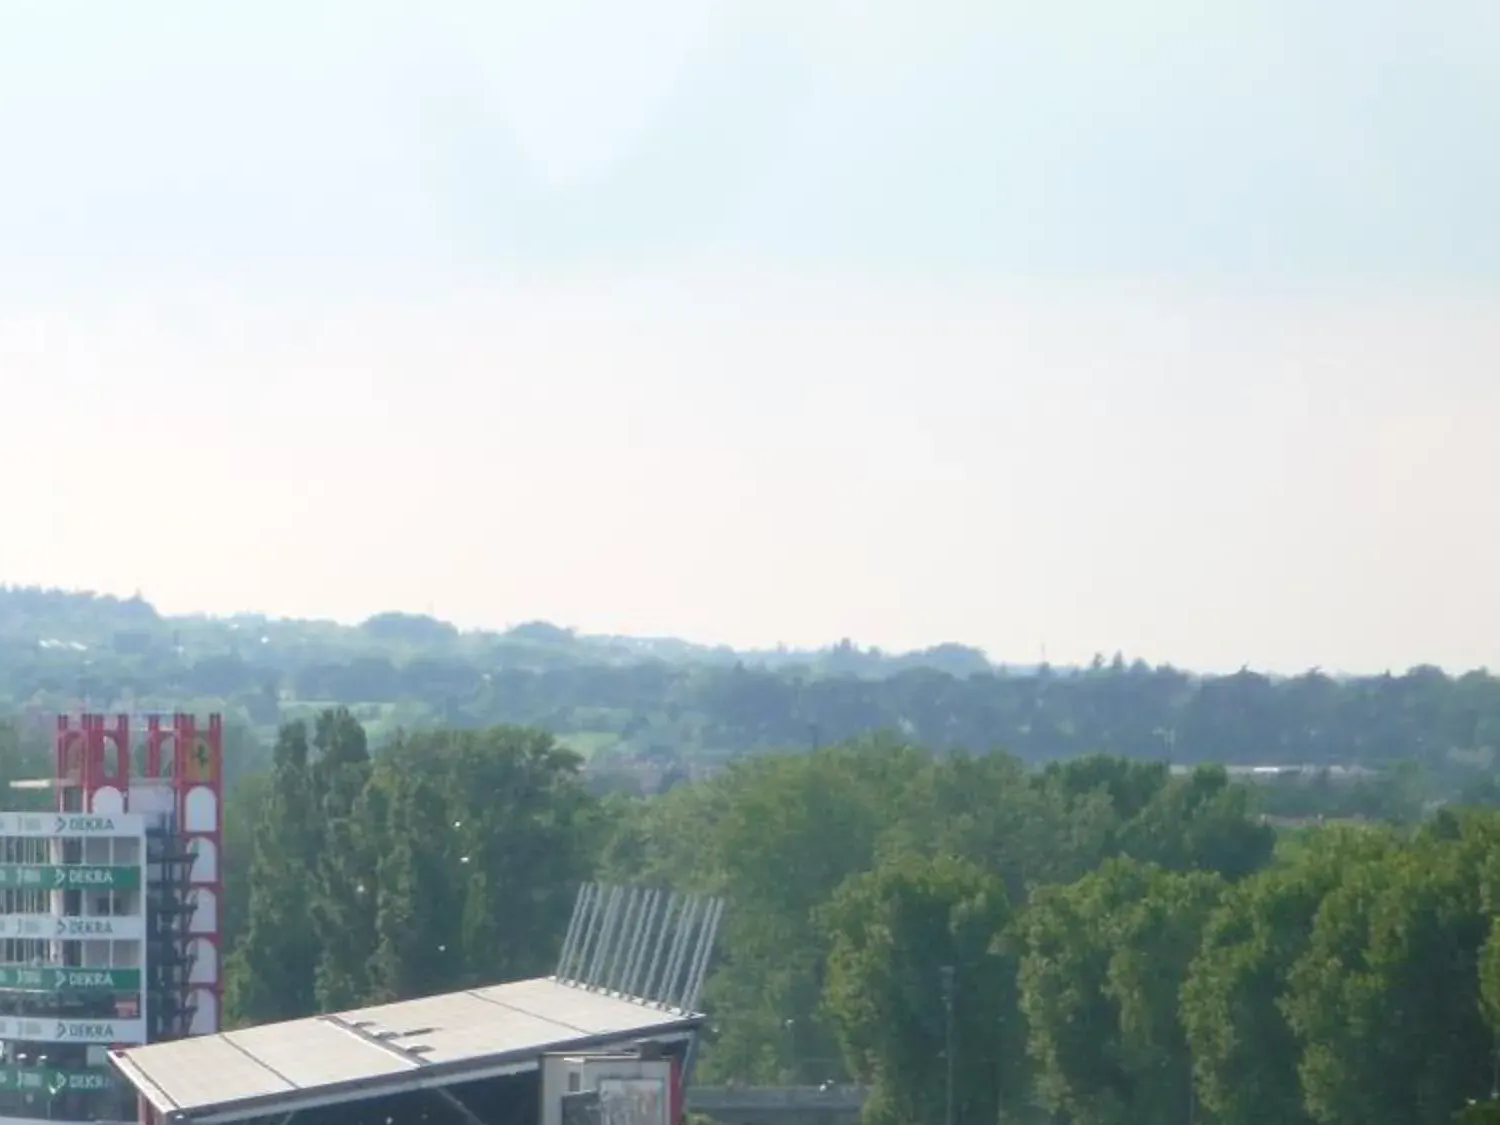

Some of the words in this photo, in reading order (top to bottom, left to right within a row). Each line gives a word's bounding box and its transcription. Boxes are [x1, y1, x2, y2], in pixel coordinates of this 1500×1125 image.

[69, 818, 114, 830] DEKRA
[68, 868, 114, 883] DEKRA
[69, 921, 113, 934] DEKRA
[69, 972, 114, 986] DEKRA
[69, 1025, 114, 1037] DEKRA
